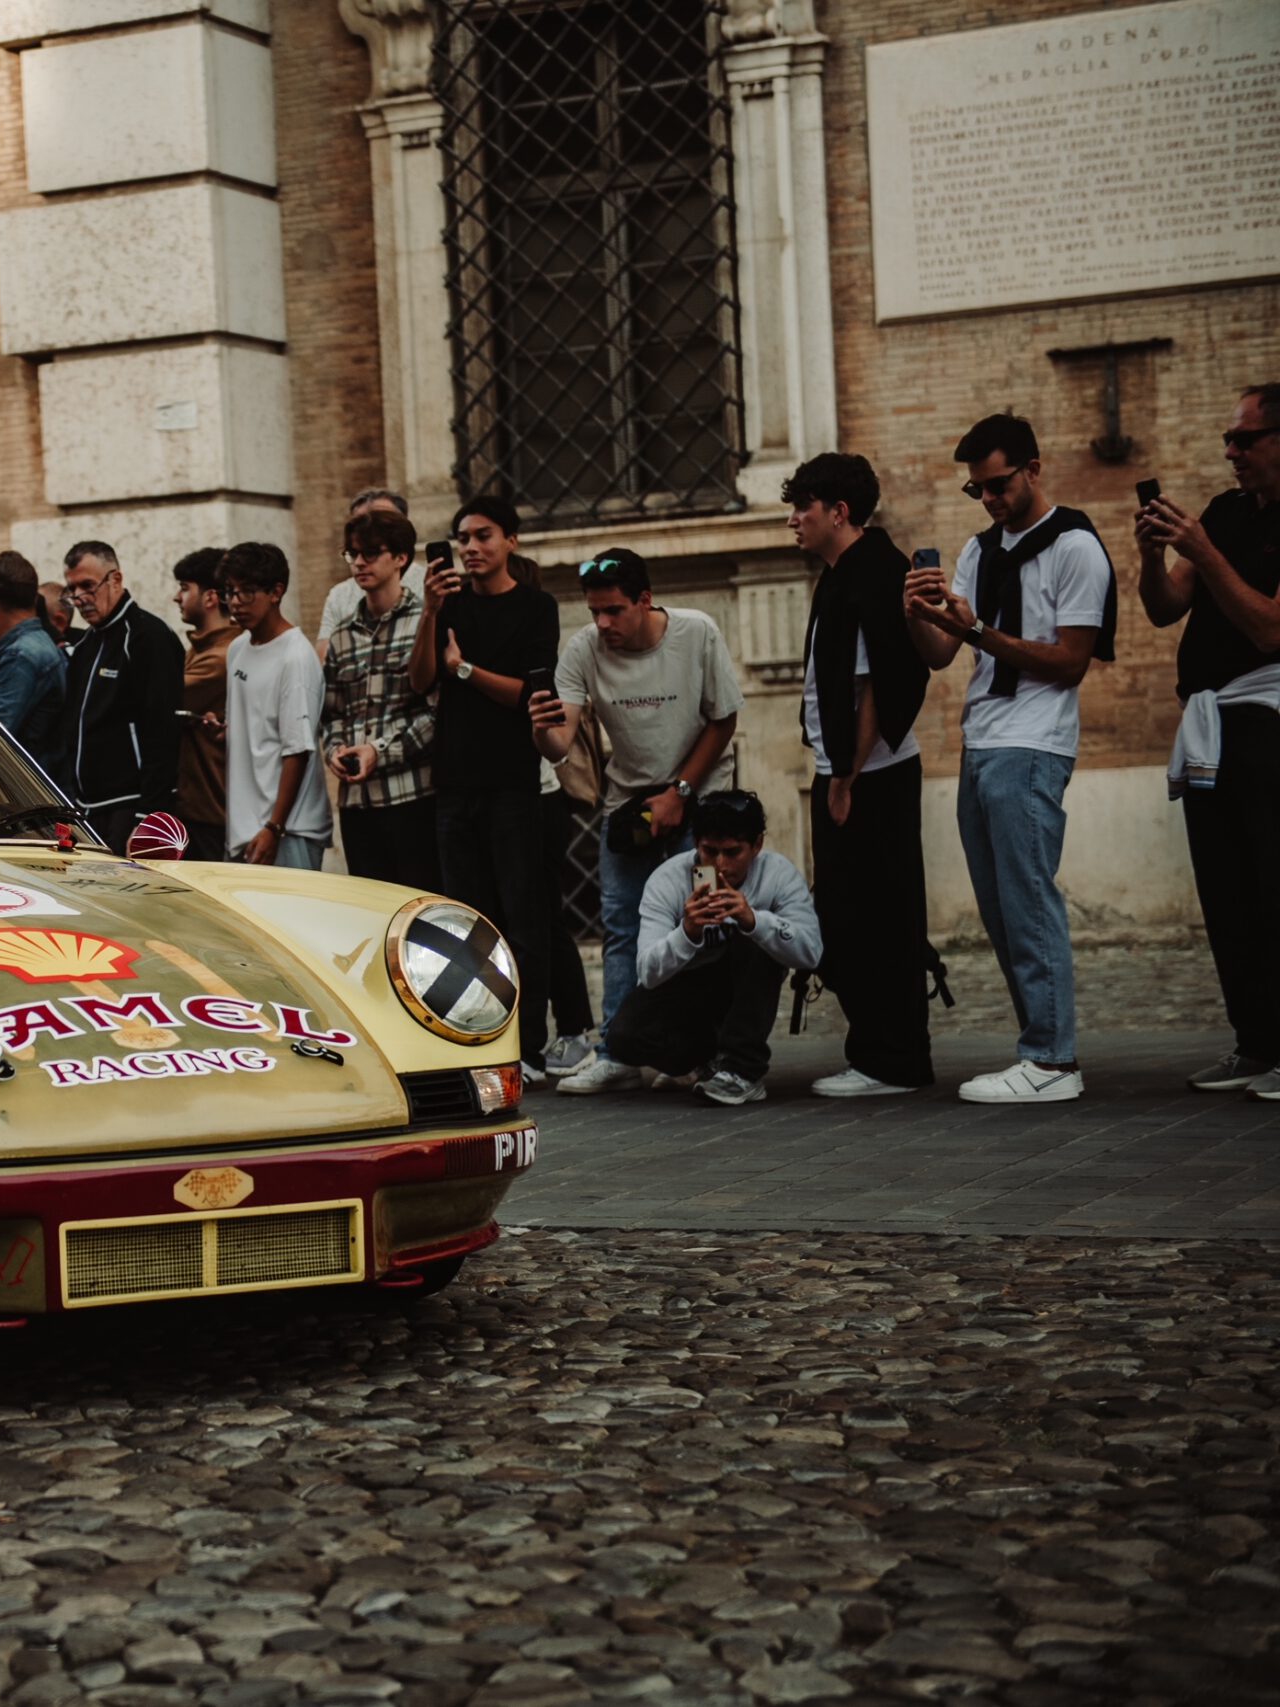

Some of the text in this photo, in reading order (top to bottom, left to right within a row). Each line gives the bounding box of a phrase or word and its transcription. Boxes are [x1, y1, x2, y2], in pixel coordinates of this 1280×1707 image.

[1034, 25, 1158, 55] MODENA
[988, 43, 1209, 85] MEDAGLIA D'ORO
[42, 1047, 277, 1086] RACING
[494, 1127, 539, 1171] PIR
